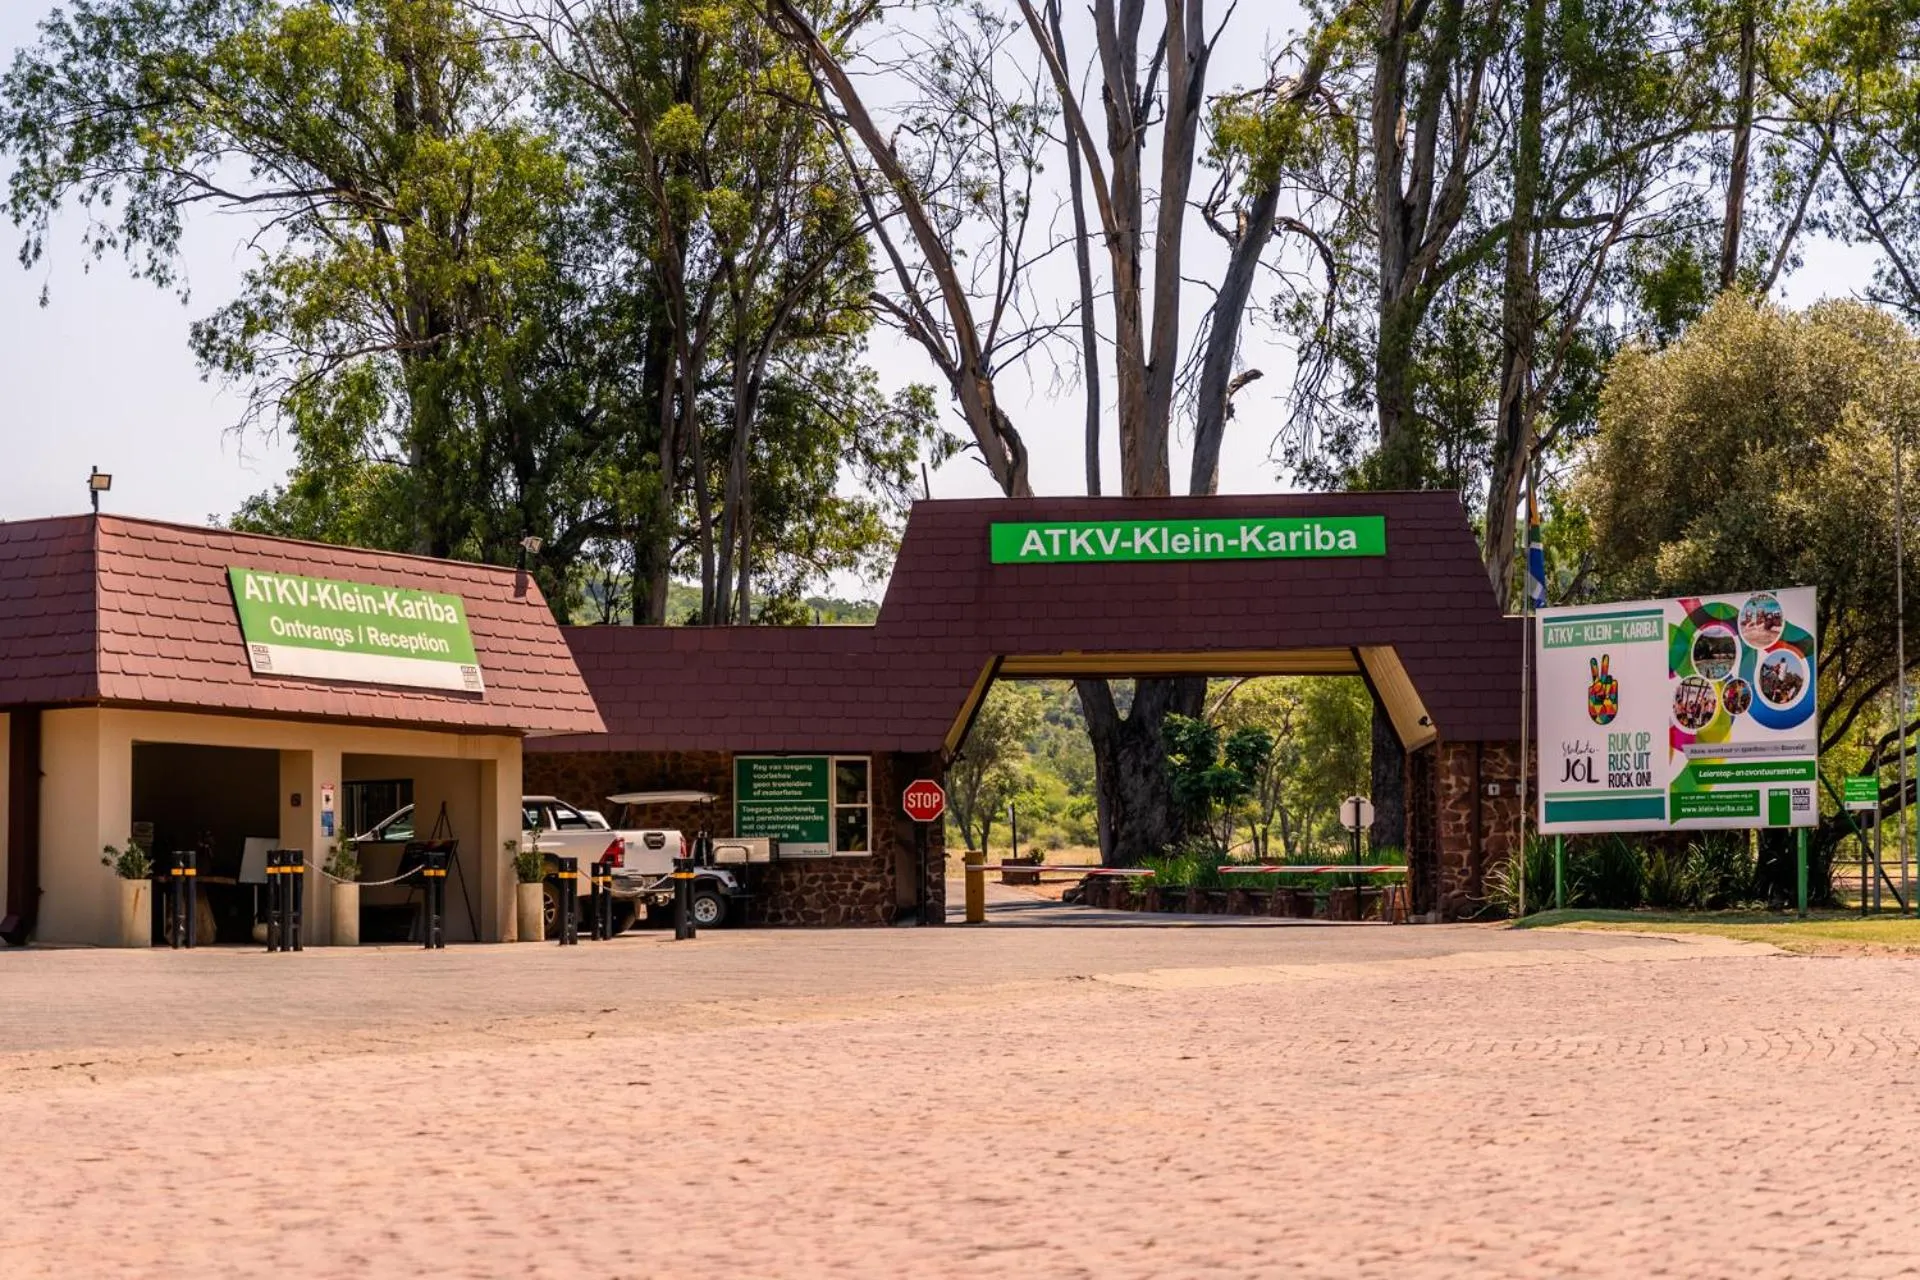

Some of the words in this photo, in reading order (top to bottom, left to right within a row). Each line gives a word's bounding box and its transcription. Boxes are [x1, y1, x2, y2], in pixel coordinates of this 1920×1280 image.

[1019, 523, 1357, 557] ATKV-Klein-Kariba
[244, 573, 459, 624] ATKV-Klein-Kariba
[270, 616, 355, 647] Ontvangs
[368, 626, 450, 654] Reception
[1547, 627, 1574, 644] ATKV
[1584, 624, 1612, 641] KLEIN
[1622, 621, 1660, 639] KARIBA
[1608, 733, 1632, 752] RUK
[1635, 732, 1651, 751] OP
[1560, 756, 1600, 783] JOL
[1608, 753, 1631, 771] RUS
[1634, 752, 1651, 770] UIT
[1608, 772, 1633, 788] ROCK
[742, 806, 773, 814] Toegang
[907, 792, 941, 809] STOP
